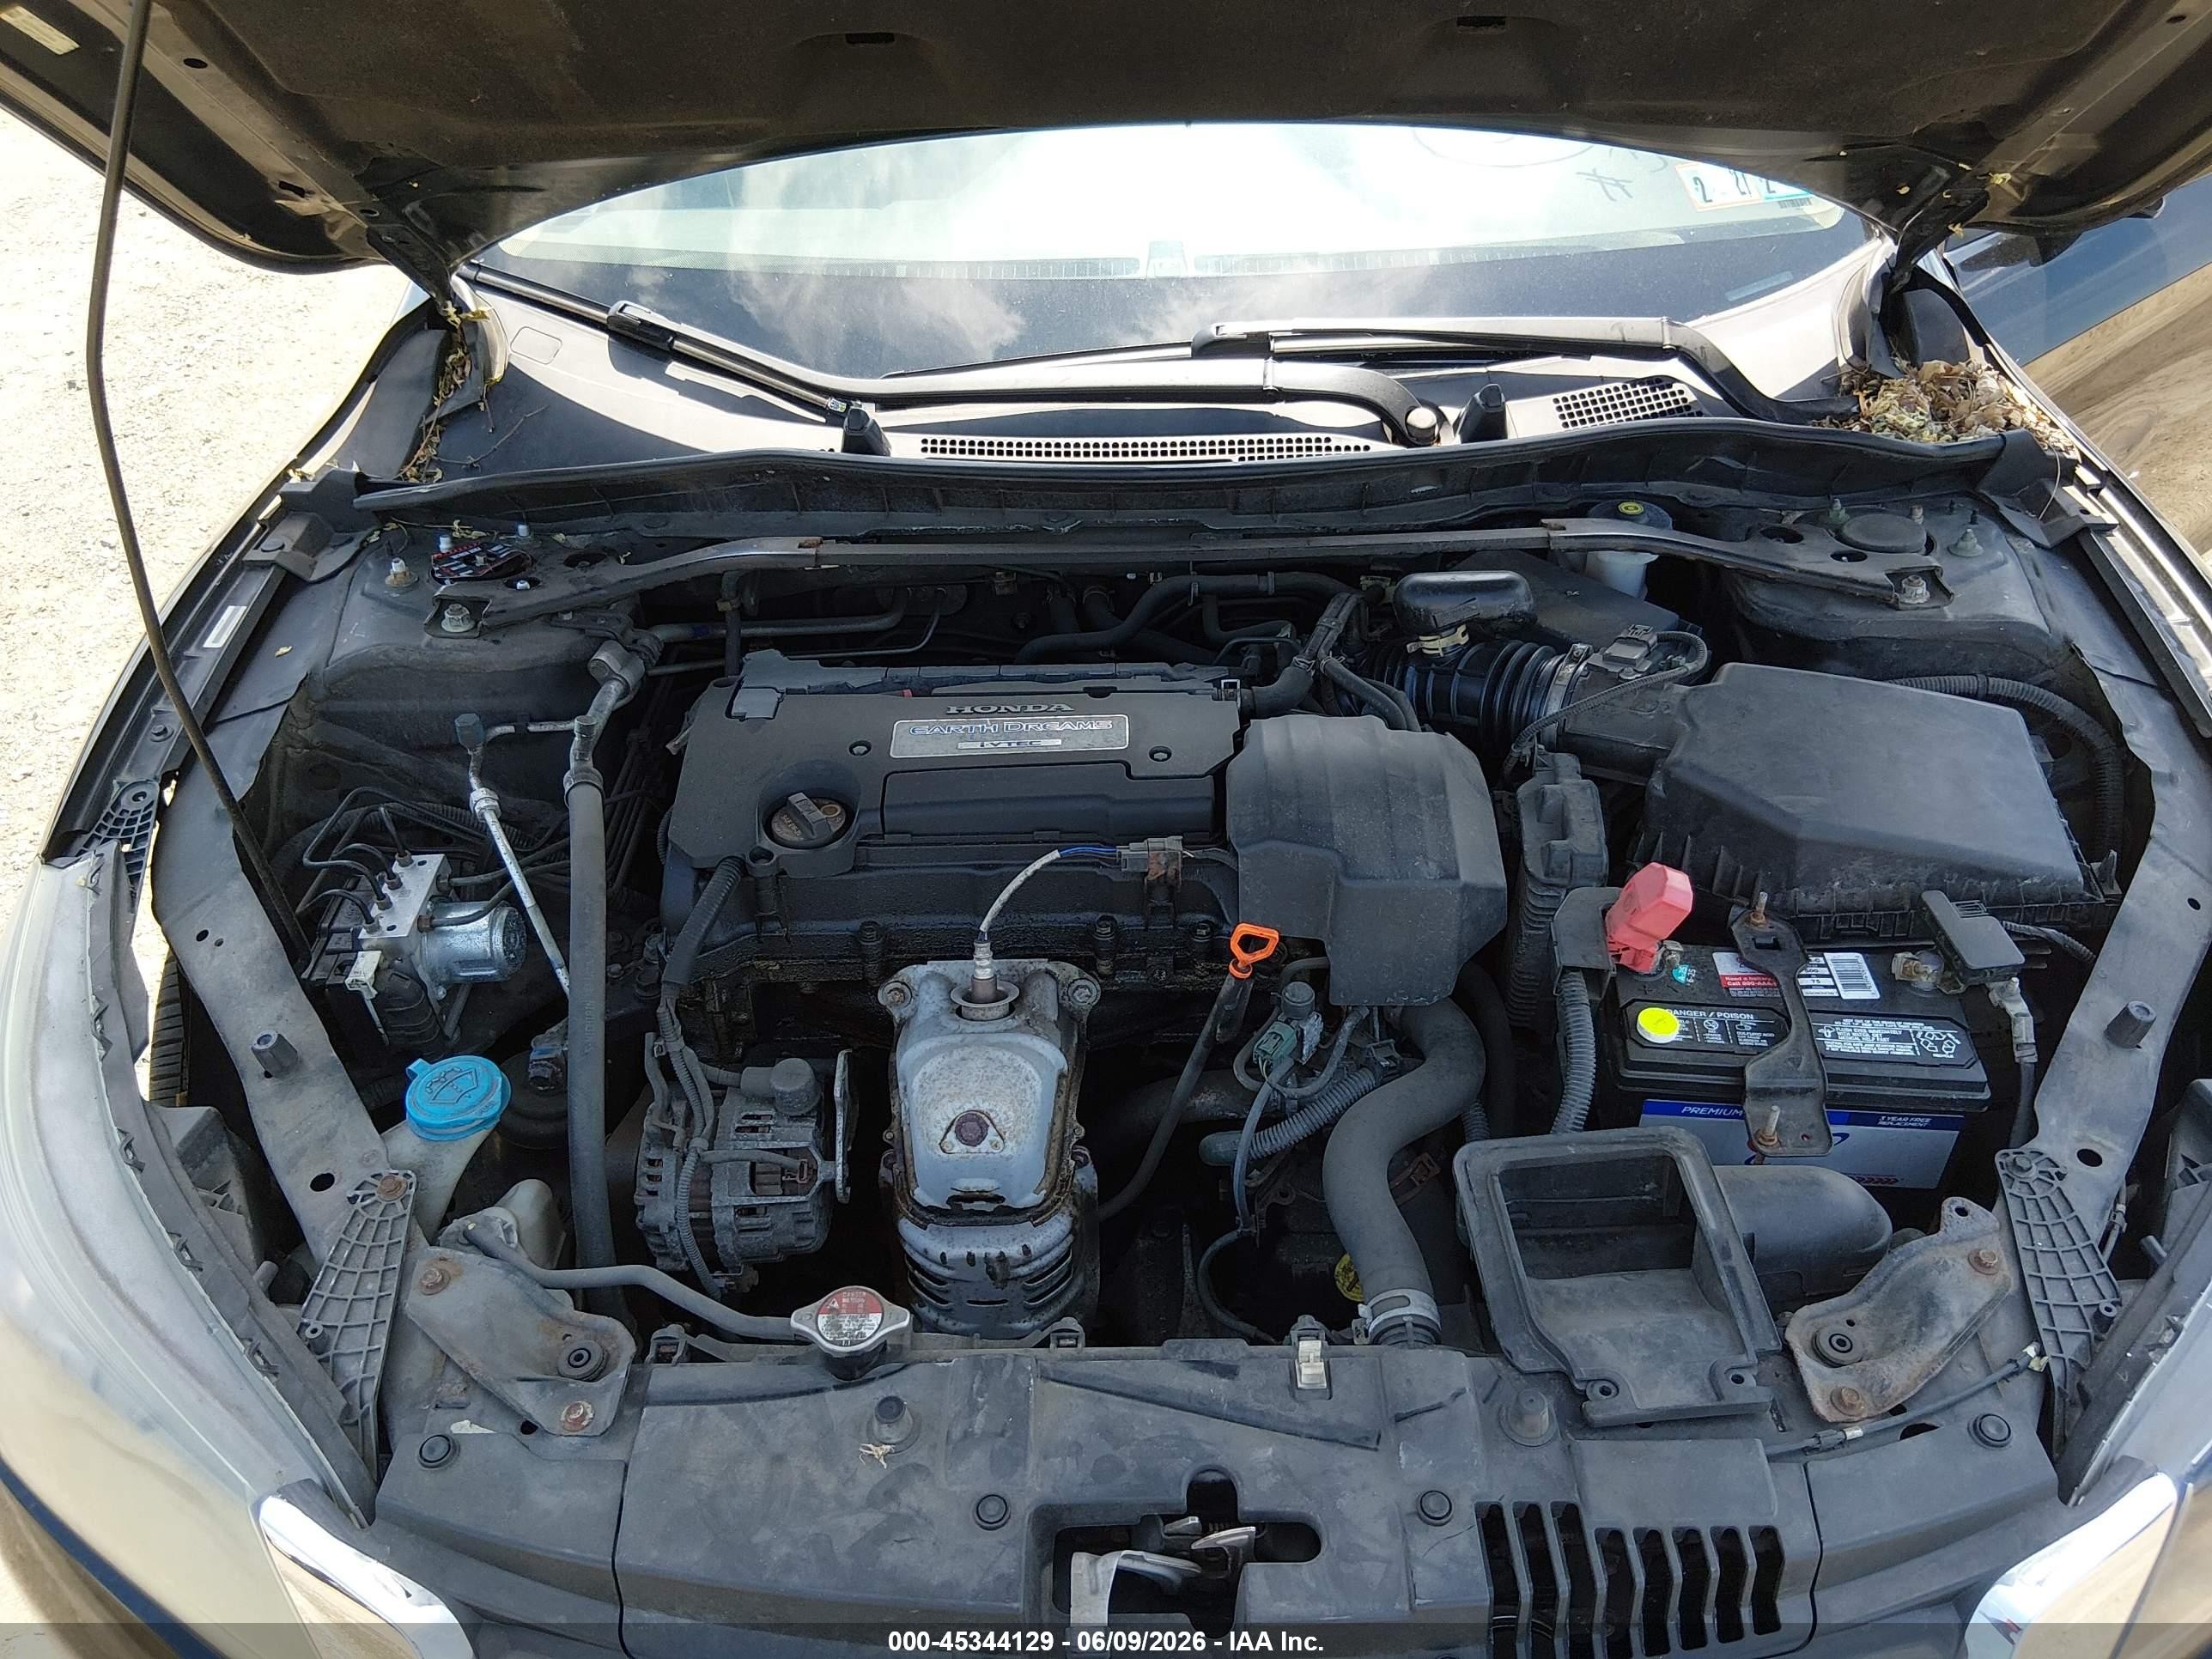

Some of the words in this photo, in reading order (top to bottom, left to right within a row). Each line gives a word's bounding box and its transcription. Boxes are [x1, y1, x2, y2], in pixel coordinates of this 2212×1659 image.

[946, 703, 1075, 714] HONDA
[908, 722, 1000, 736] EARTH
[979, 739, 1042, 749] i-VTEC
[1681, 1106, 1743, 1116] PREMIUM
